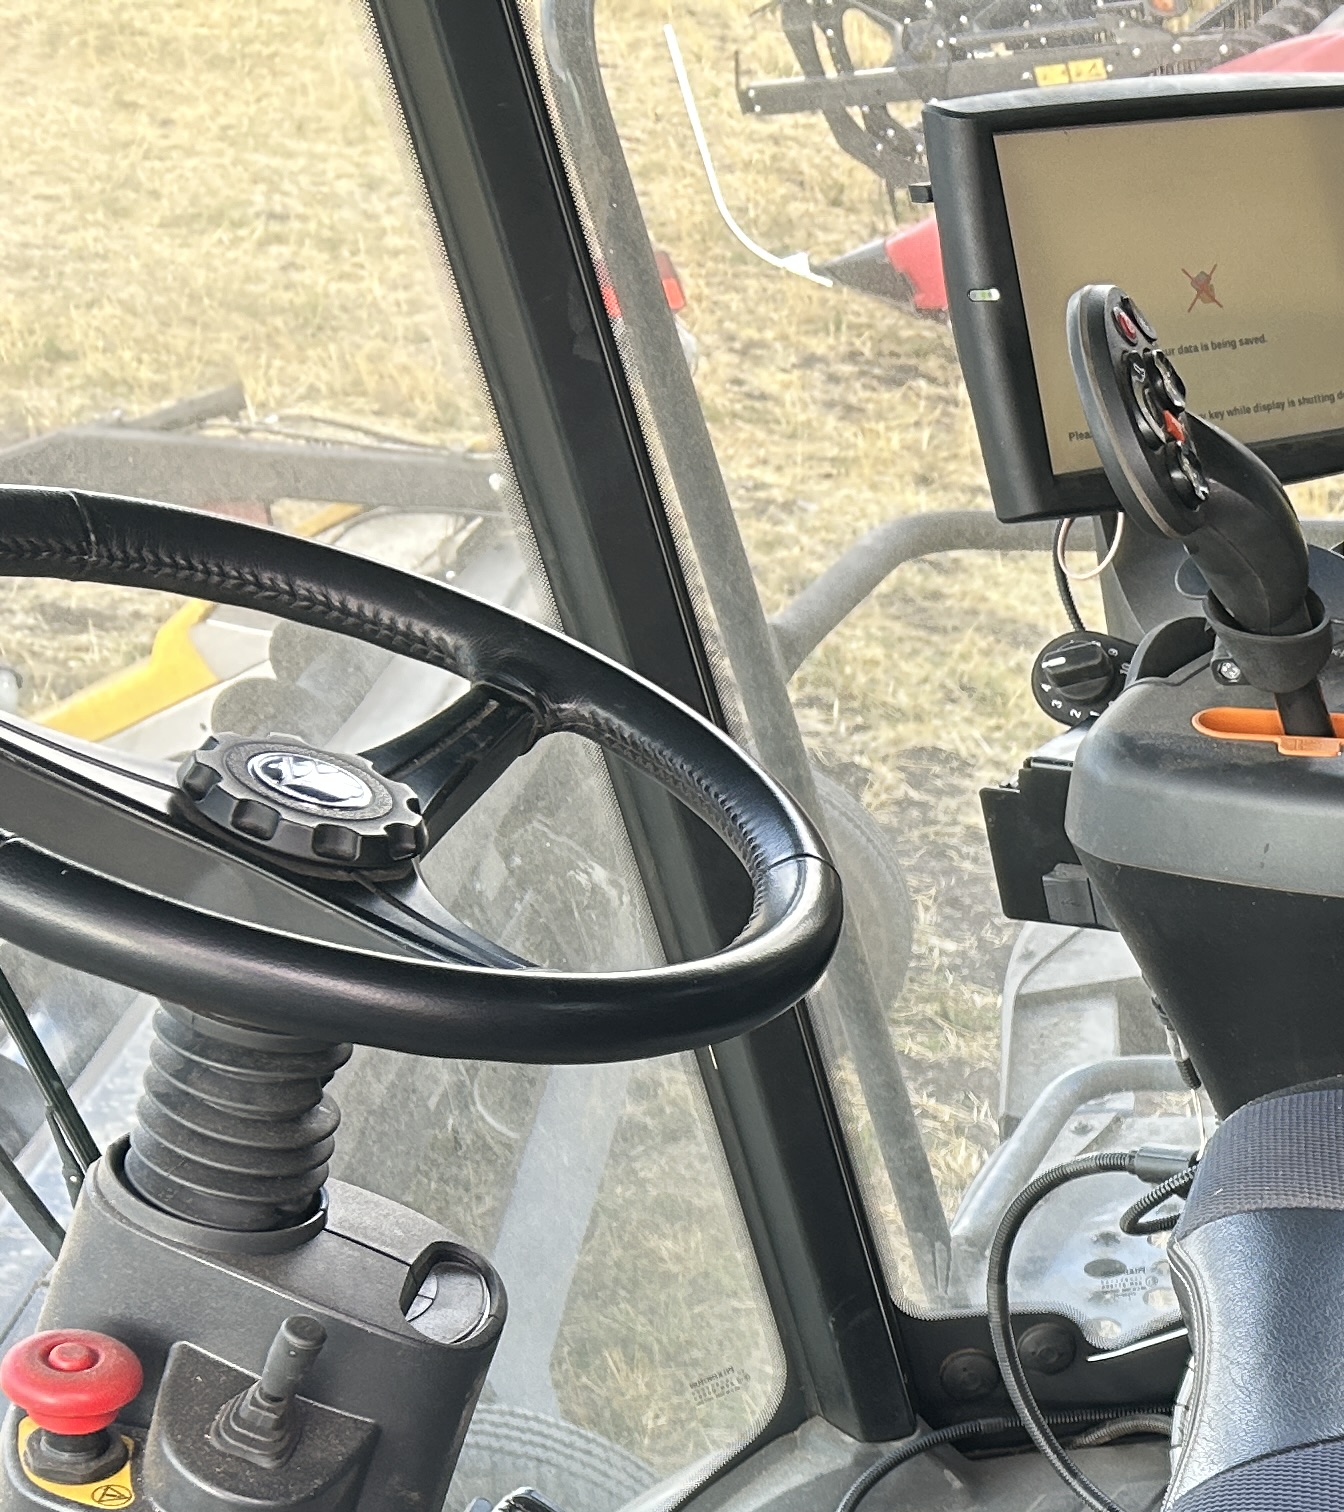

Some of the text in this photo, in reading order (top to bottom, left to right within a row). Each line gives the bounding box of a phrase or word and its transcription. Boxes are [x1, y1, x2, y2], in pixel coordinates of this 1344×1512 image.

[1177, 345, 1200, 355] data
[1201, 343, 1210, 352] is
[1211, 339, 1238, 350] being
[1068, 431, 1092, 441] Plea
[1208, 410, 1225, 420] key
[1226, 405, 1252, 417] while
[1253, 400, 1286, 414] display
[1287, 397, 1296, 408] is
[1297, 395, 1335, 406] shutting
